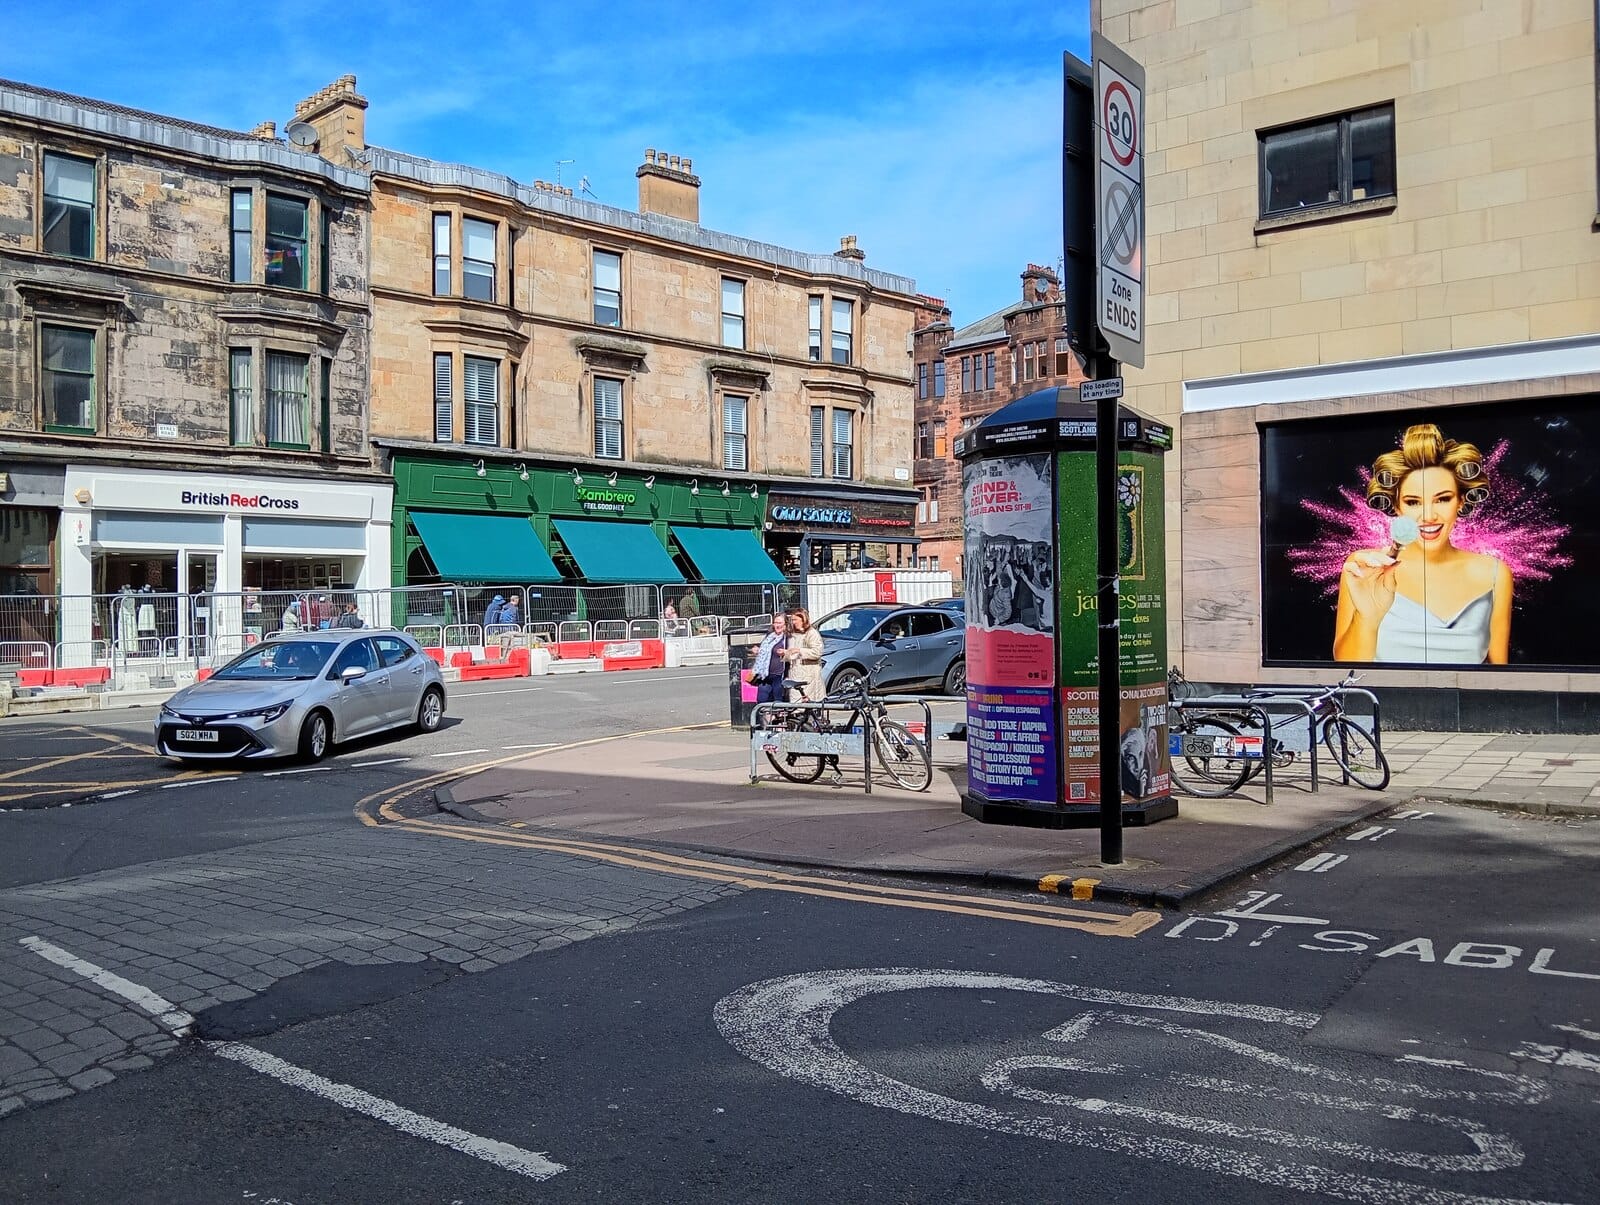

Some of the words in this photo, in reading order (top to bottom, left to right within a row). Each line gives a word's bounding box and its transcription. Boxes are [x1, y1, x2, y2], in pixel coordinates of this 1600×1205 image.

[1110, 102, 1132, 144] 30
[1111, 278, 1132, 302] Zone
[1106, 300, 1137, 330] ENDS
[1095, 381, 1120, 389] loading
[972, 481, 1009, 496] STAND
[1010, 480, 1017, 491] &
[181, 491, 299, 510] BritishRedCross
[180, 731, 197, 739] SG21
[1012, 765, 1032, 775] FLOOR
[1011, 776, 1024, 786] POT
